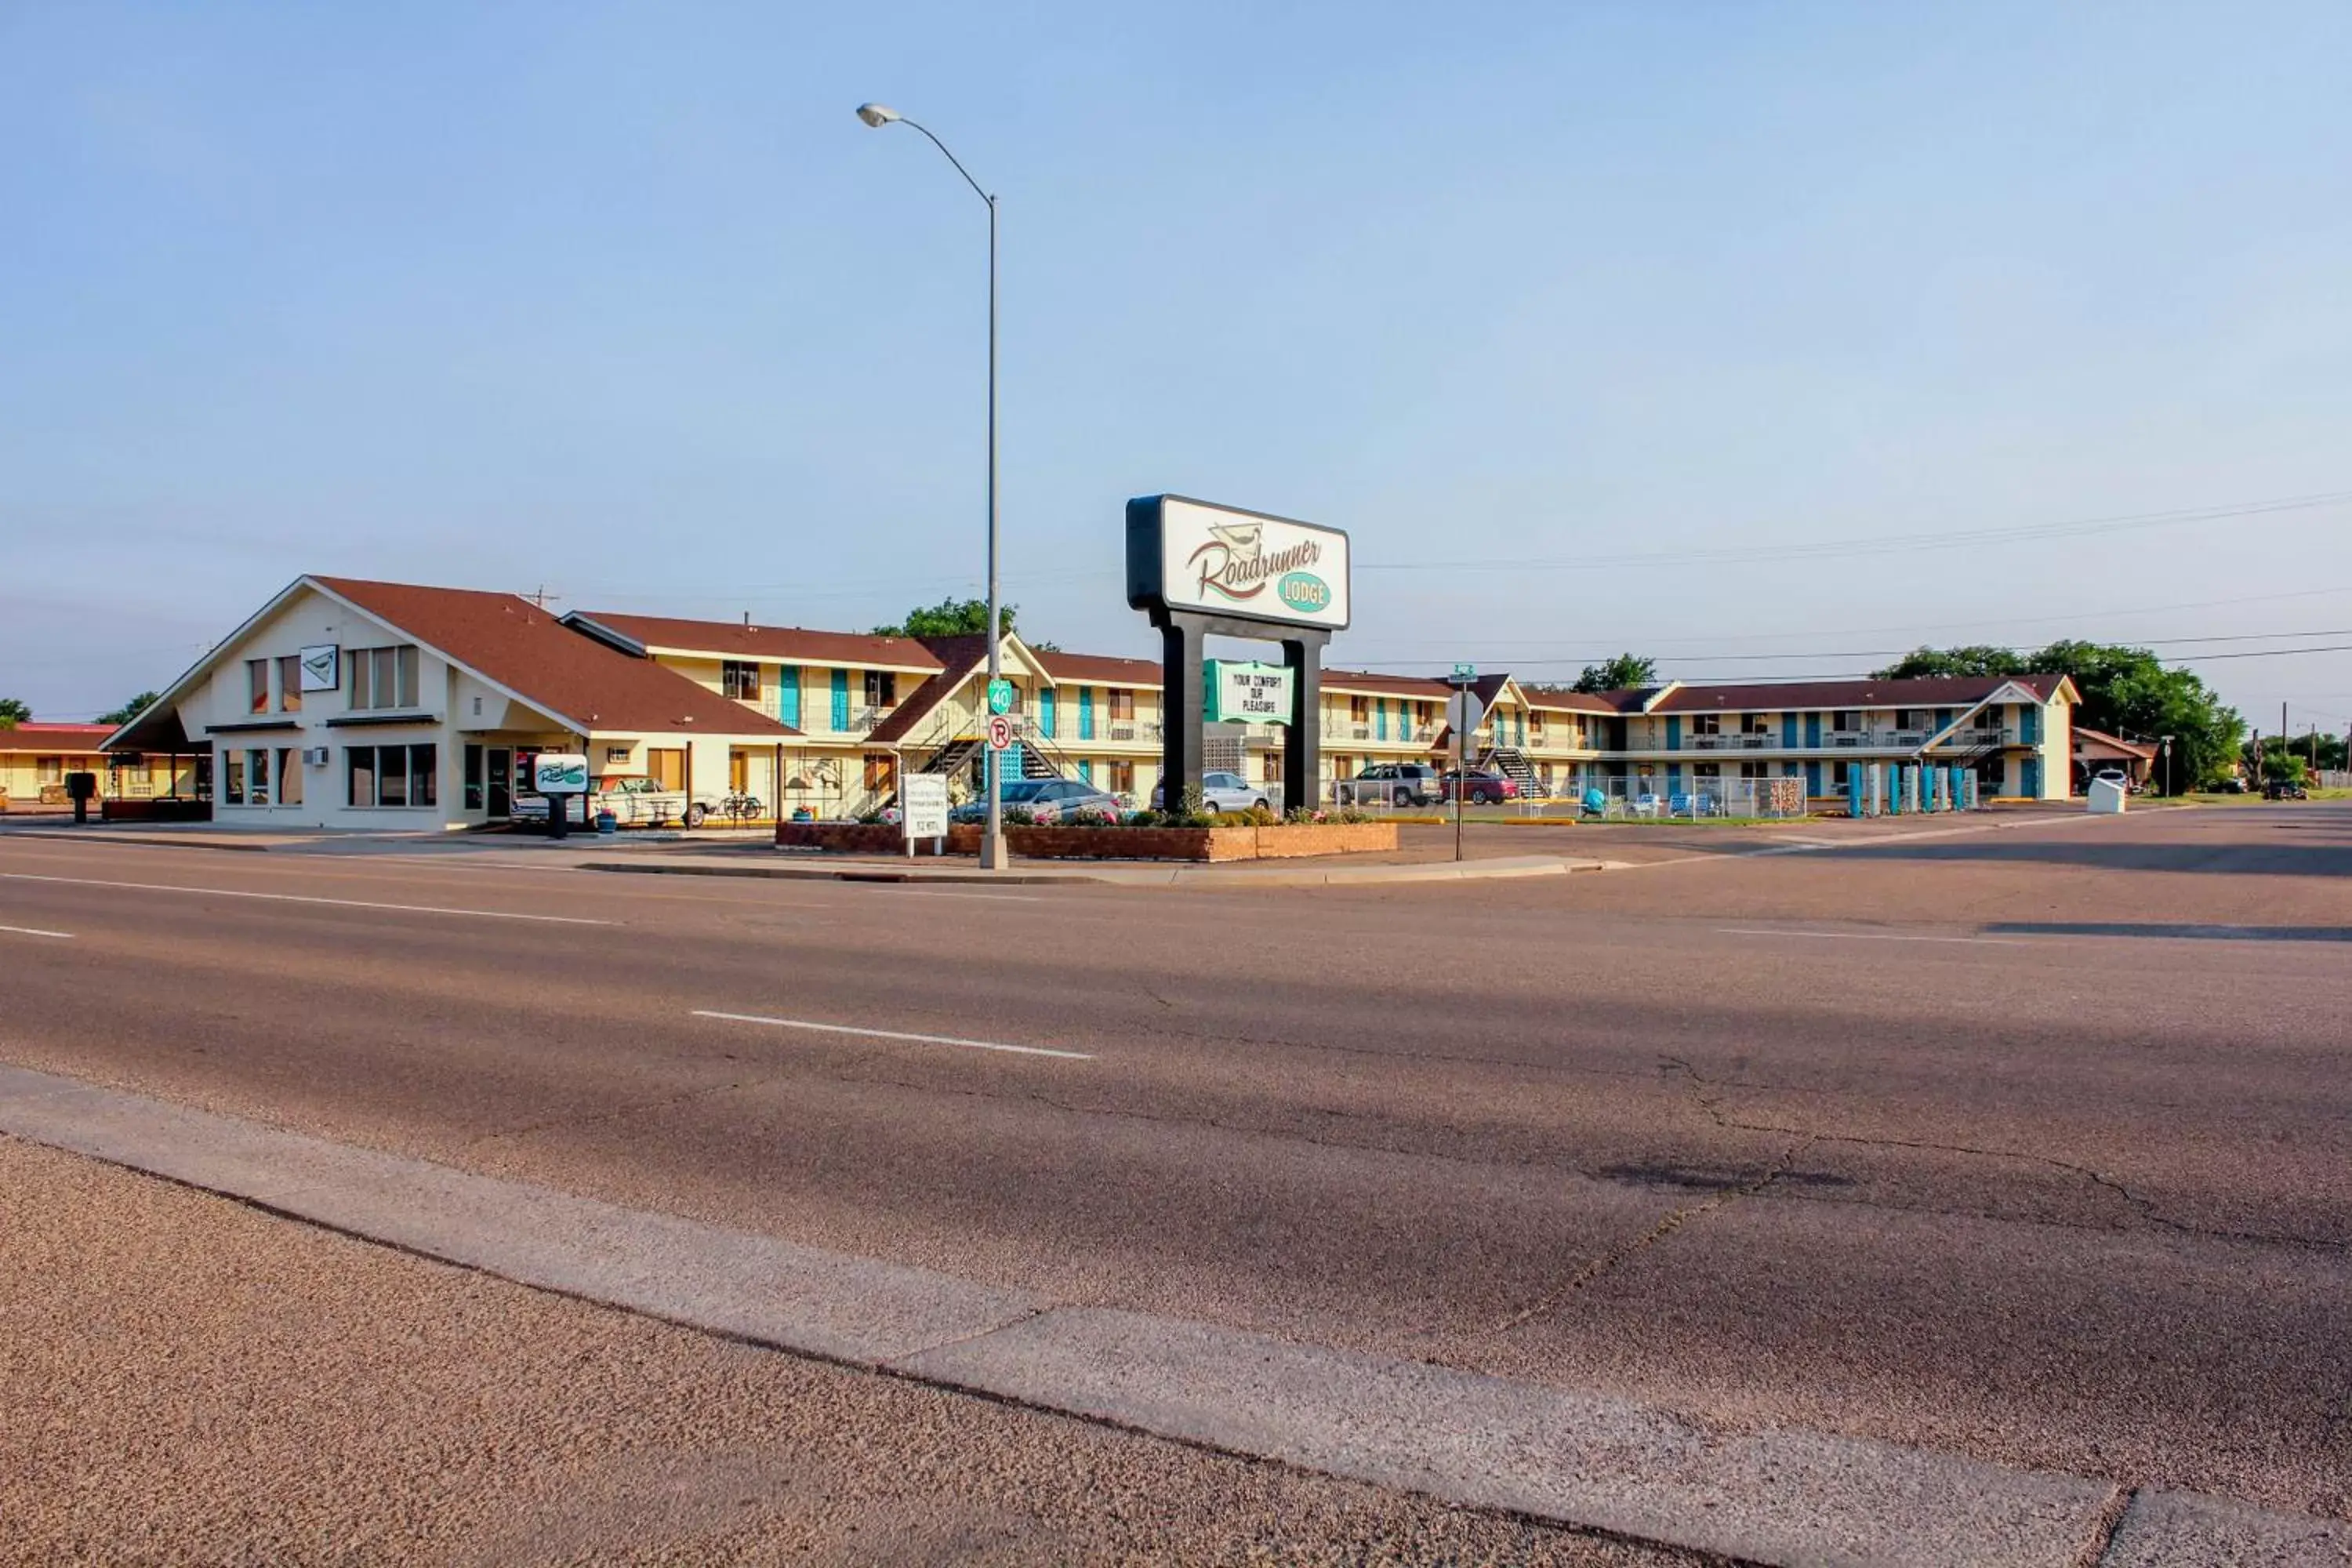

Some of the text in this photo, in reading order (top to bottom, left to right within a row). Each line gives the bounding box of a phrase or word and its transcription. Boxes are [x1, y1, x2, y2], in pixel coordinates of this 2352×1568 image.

[1185, 539, 1322, 601] Roadrunner
[1284, 579, 1325, 604] LODGE
[1233, 674, 1250, 686] YOUR
[992, 689, 1010, 706] 40
[1250, 688, 1263, 699] OUR
[1243, 699, 1276, 713] PLEASURE
